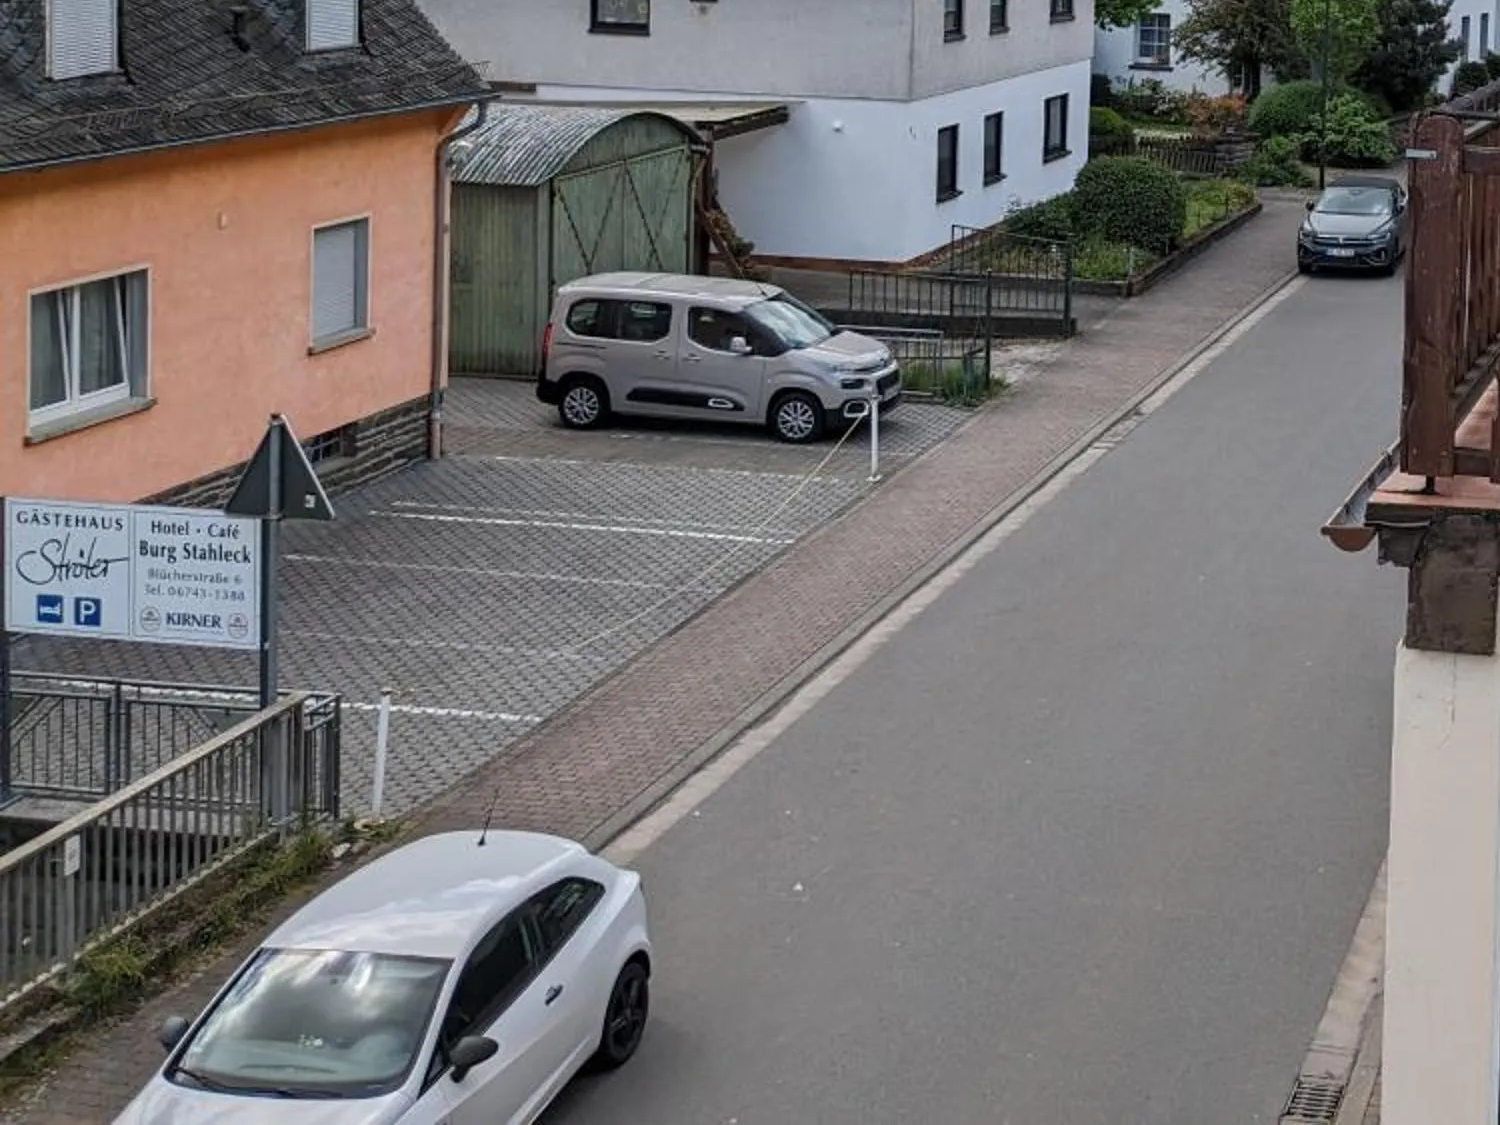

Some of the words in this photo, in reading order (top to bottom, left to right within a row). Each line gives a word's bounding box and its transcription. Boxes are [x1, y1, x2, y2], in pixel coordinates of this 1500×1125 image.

[16, 509, 123, 531] GÄSTEHAUS
[151, 520, 189, 536] Hotel
[207, 523, 240, 539] Café
[139, 540, 177, 564] Burg
[183, 542, 251, 564] Stahleck
[166, 612, 222, 629] KIRNER
